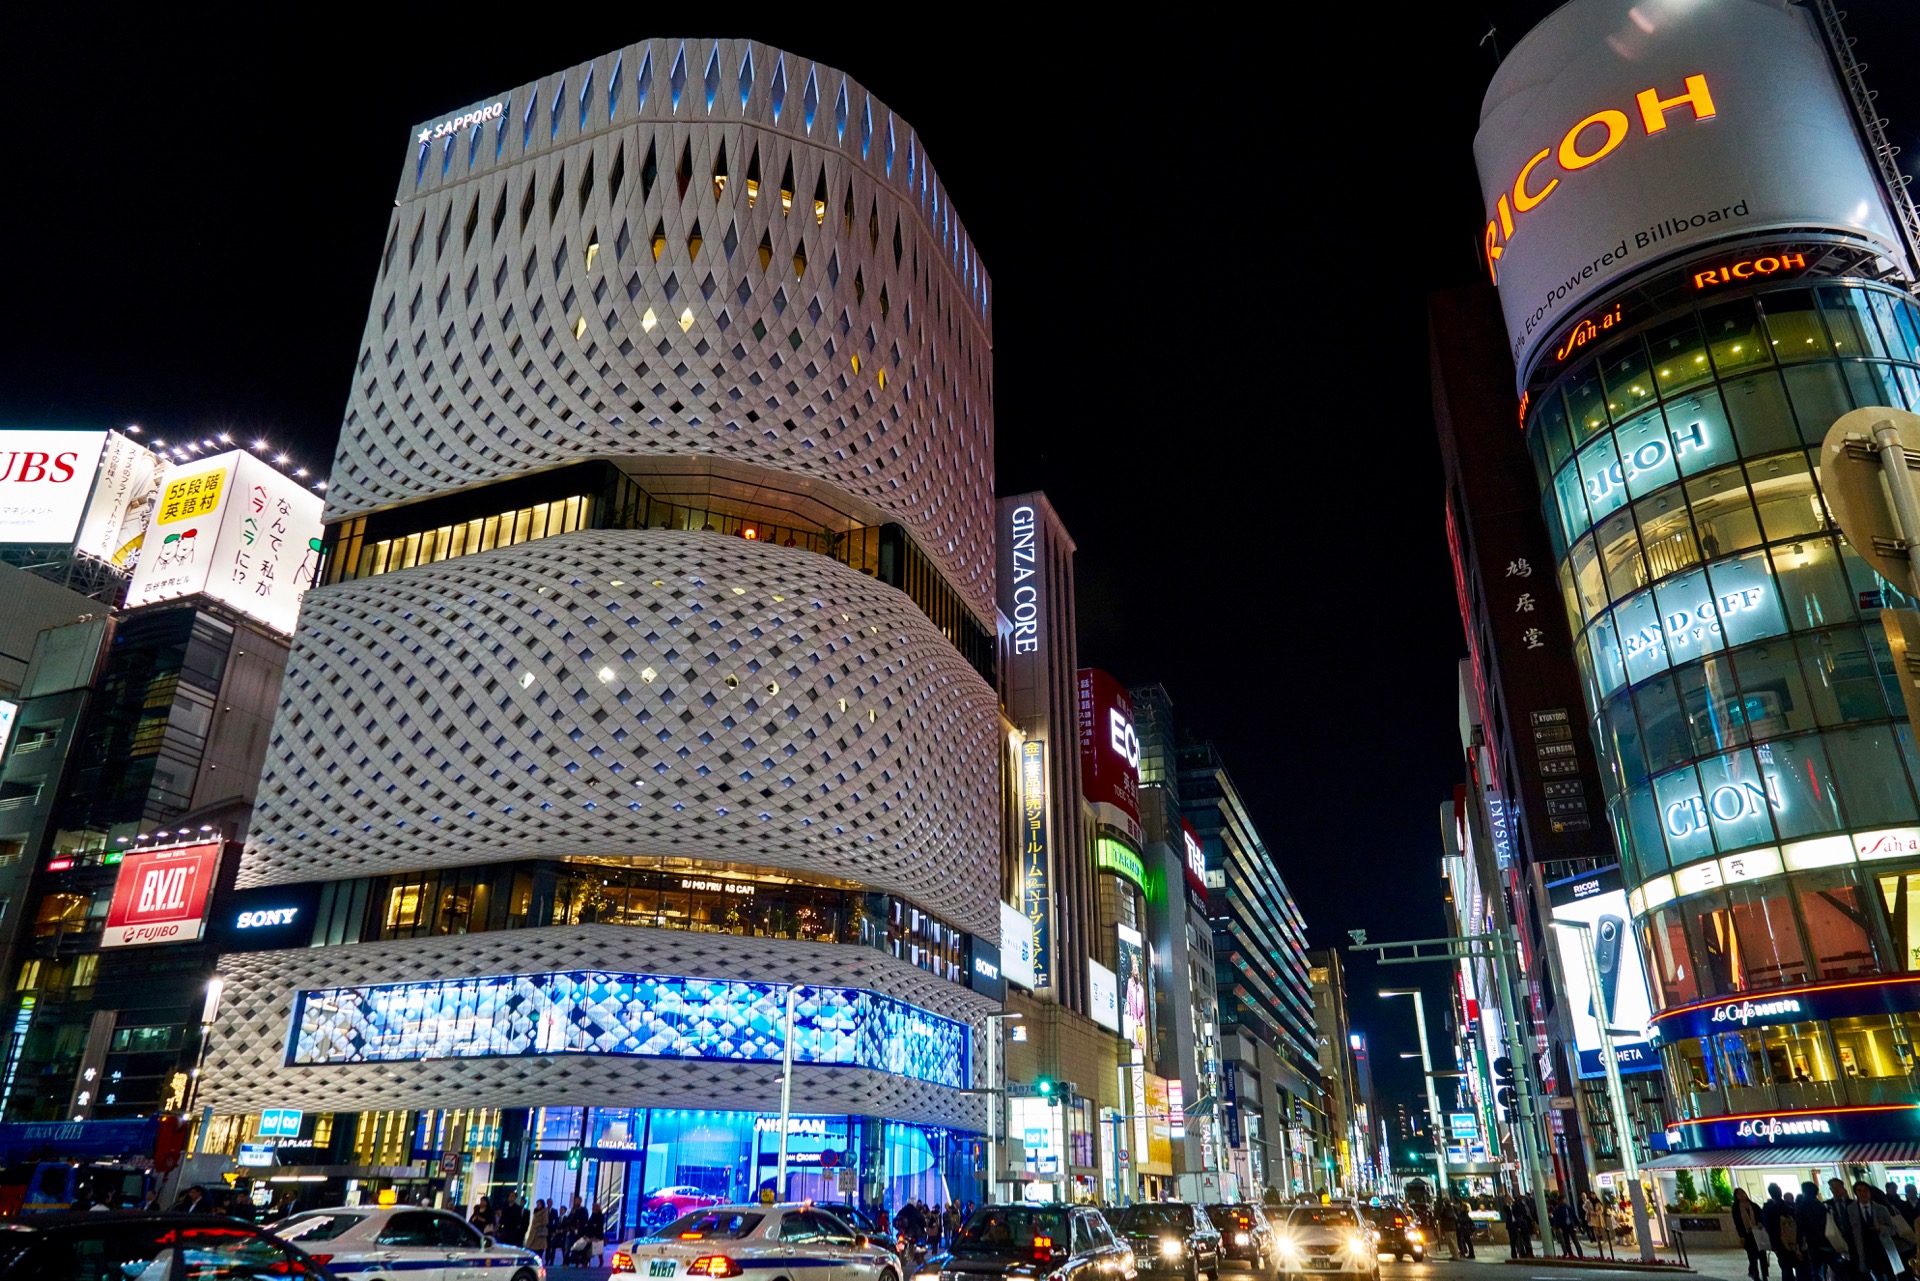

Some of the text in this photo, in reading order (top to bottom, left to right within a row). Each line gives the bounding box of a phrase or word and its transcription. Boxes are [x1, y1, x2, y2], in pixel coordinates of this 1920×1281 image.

[433, 102, 503, 139] SAPPORO
[1485, 74, 1716, 287] RICOH
[1525, 240, 1629, 335] Eco-Powered
[1635, 200, 1749, 250] Billboard
[1694, 253, 1806, 289] RICOH
[1557, 303, 1622, 361] San-ai
[169, 473, 220, 500] 55段階
[164, 492, 215, 520] 英語村
[1012, 506, 1038, 655] GINZA CORE
[1505, 557, 1545, 650] 鳩居堂
[1696, 586, 1762, 621] OFF
[1547, 786, 1554, 794] 3
[1489, 799, 1512, 862] TASAKI
[1573, 880, 1599, 894] RICOH
[1701, 859, 1747, 886] 三愛
[138, 866, 188, 913] B.V.D.
[135, 924, 179, 942] FUJIBO
[237, 908, 298, 929] SONY
[975, 957, 999, 980] SONY
[1617, 1049, 1644, 1062] HETA
[617, 1141, 637, 1150] PLACE
